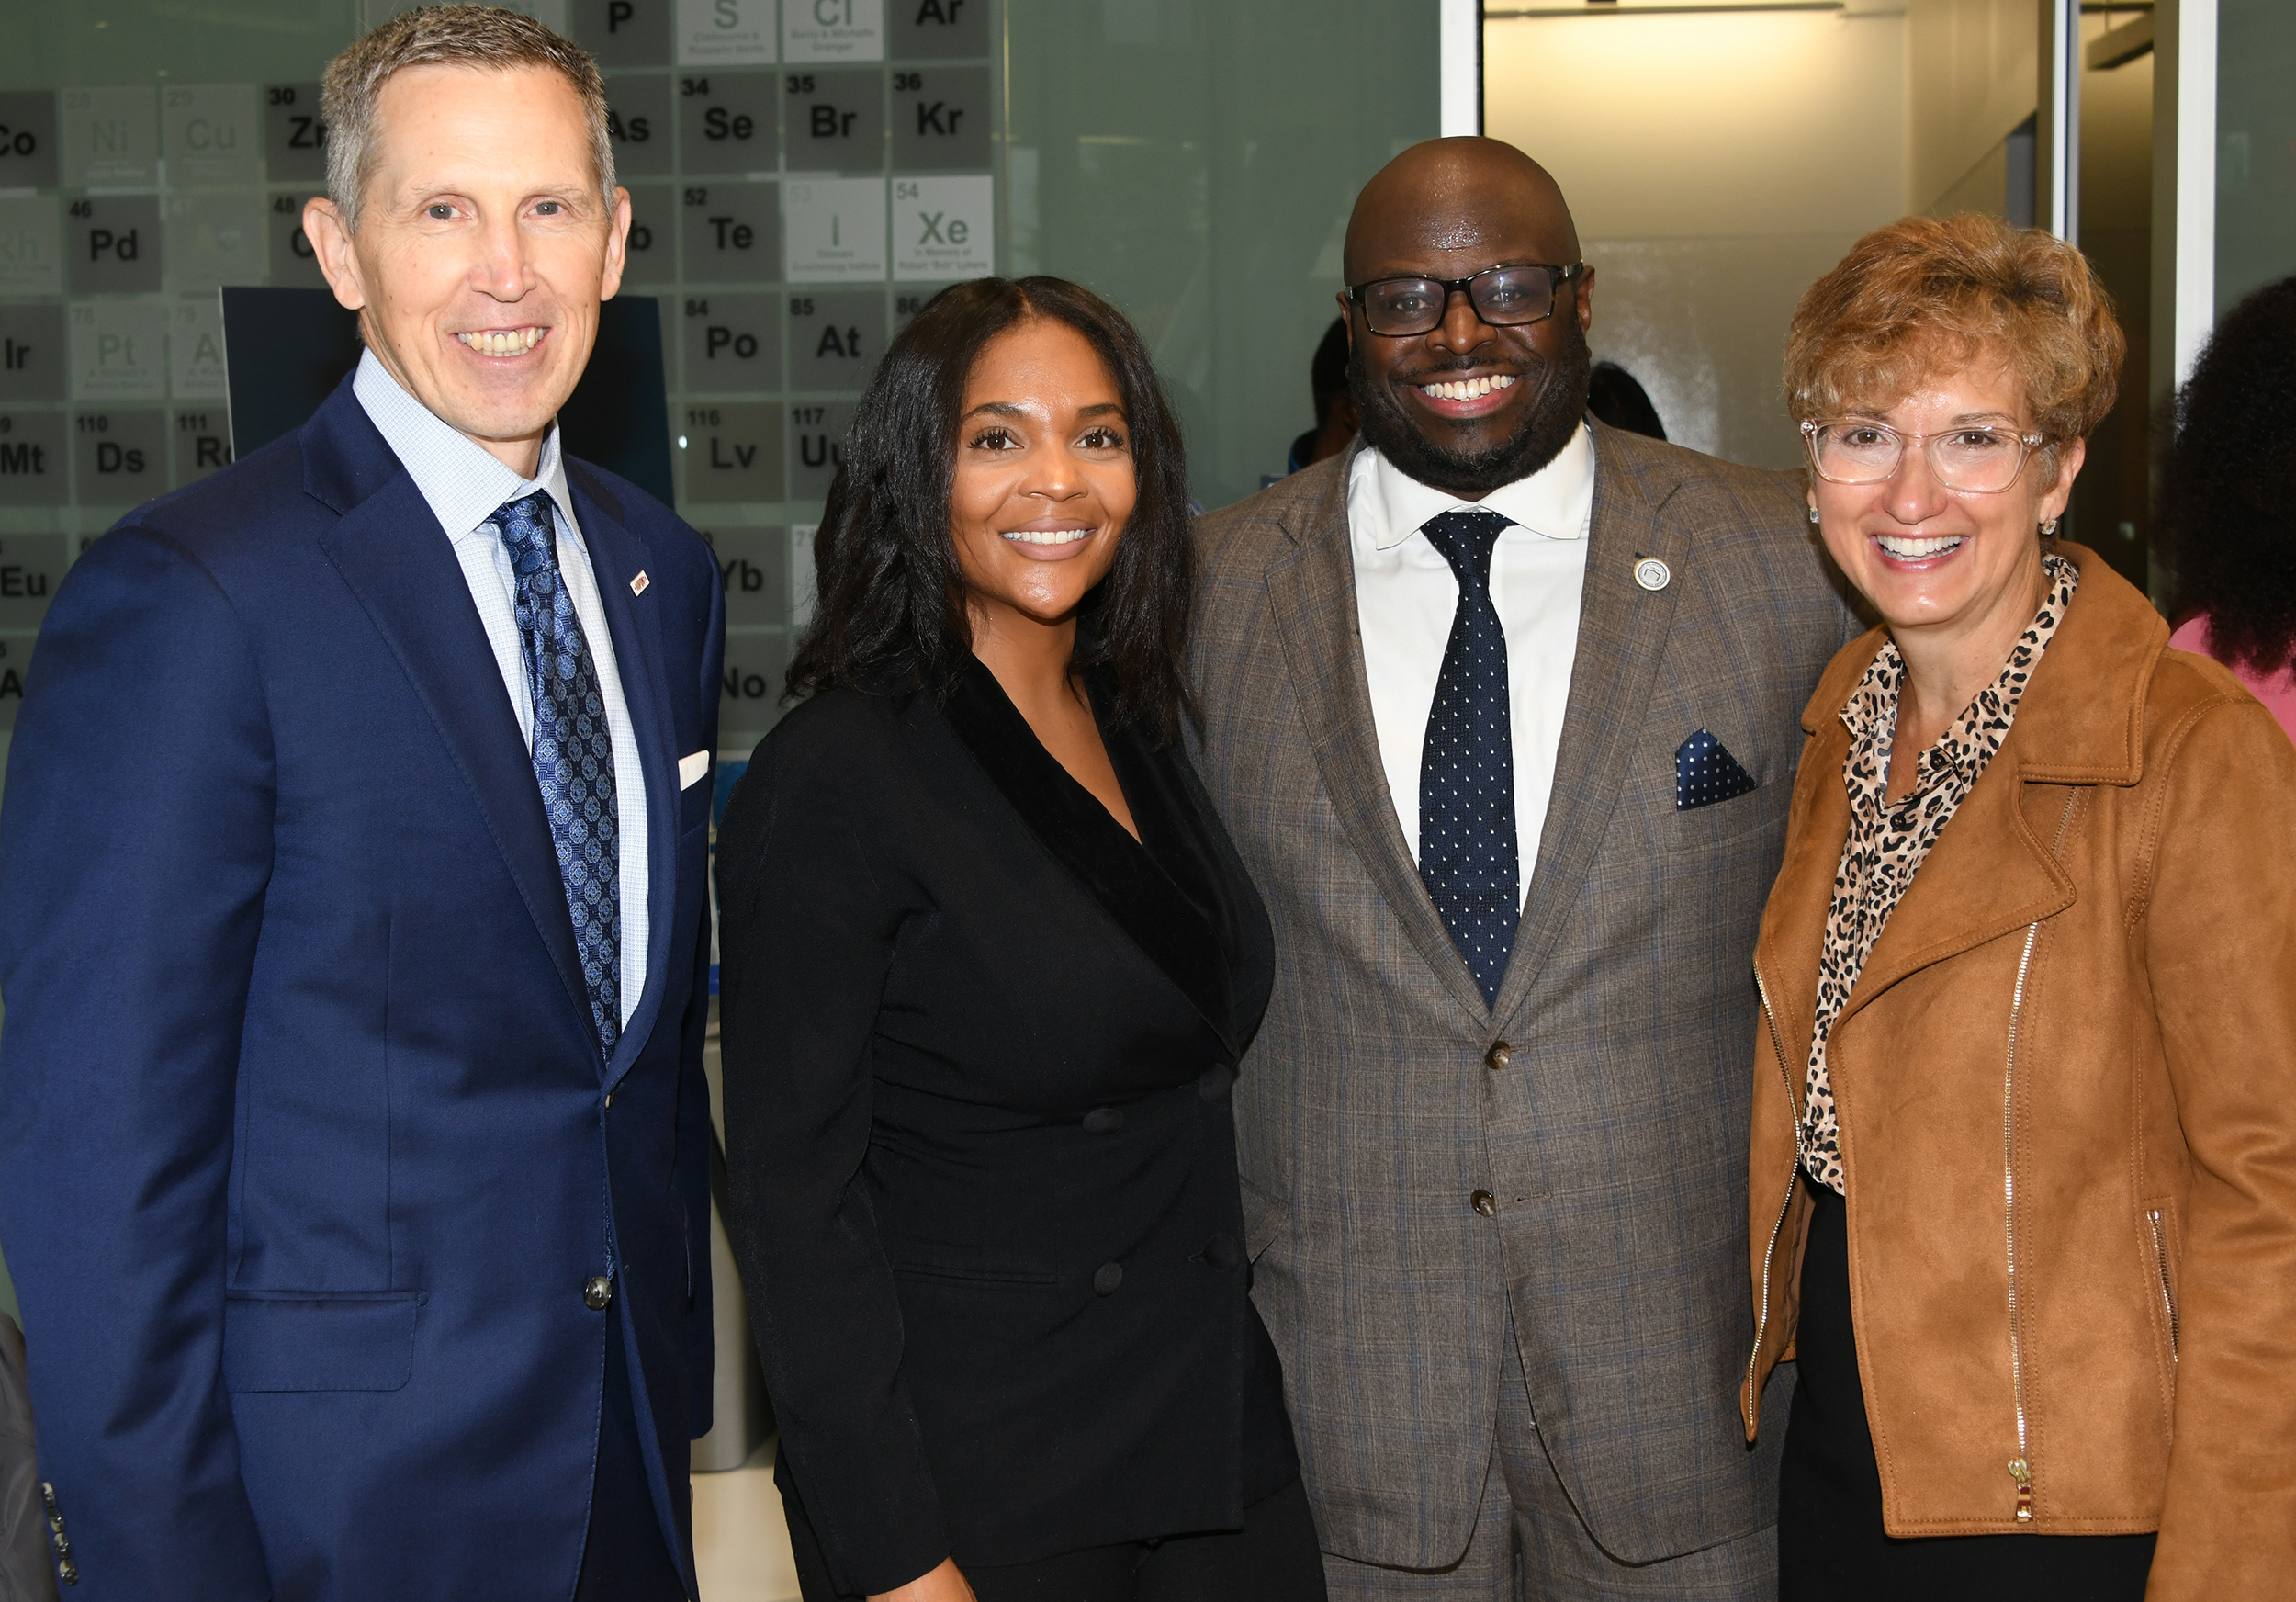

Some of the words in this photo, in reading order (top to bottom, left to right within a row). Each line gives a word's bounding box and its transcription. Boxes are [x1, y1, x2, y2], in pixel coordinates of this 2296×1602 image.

[608, 0, 635, 34] P
[714, 0, 738, 29] S
[269, 88, 296, 106] 30
[681, 79, 710, 96] 34
[787, 75, 816, 93] 35
[893, 73, 922, 91] 36
[703, 107, 754, 141] Se
[810, 104, 858, 138] Br
[917, 101, 964, 136] Kr
[91, 119, 129, 153] Ni
[186, 118, 236, 152] Cu
[273, 197, 296, 215] 48
[684, 187, 708, 206] 52
[896, 182, 919, 201] 54
[69, 199, 92, 218] 46
[709, 218, 754, 250] Te
[918, 211, 970, 245] Xe
[89, 228, 140, 262] Pd
[684, 299, 709, 317] 84
[790, 299, 815, 316] 85
[6, 337, 31, 370] Ir
[98, 333, 137, 367] Pt
[707, 326, 759, 360] Po
[816, 324, 861, 358] At
[77, 414, 108, 433] 110
[179, 413, 208, 432] 111
[687, 410, 721, 427] 116
[793, 407, 825, 425] 117
[0, 443, 45, 475] Mt
[97, 440, 146, 474] Ds
[711, 436, 758, 469] Lv
[1, 566, 48, 597] Eu
